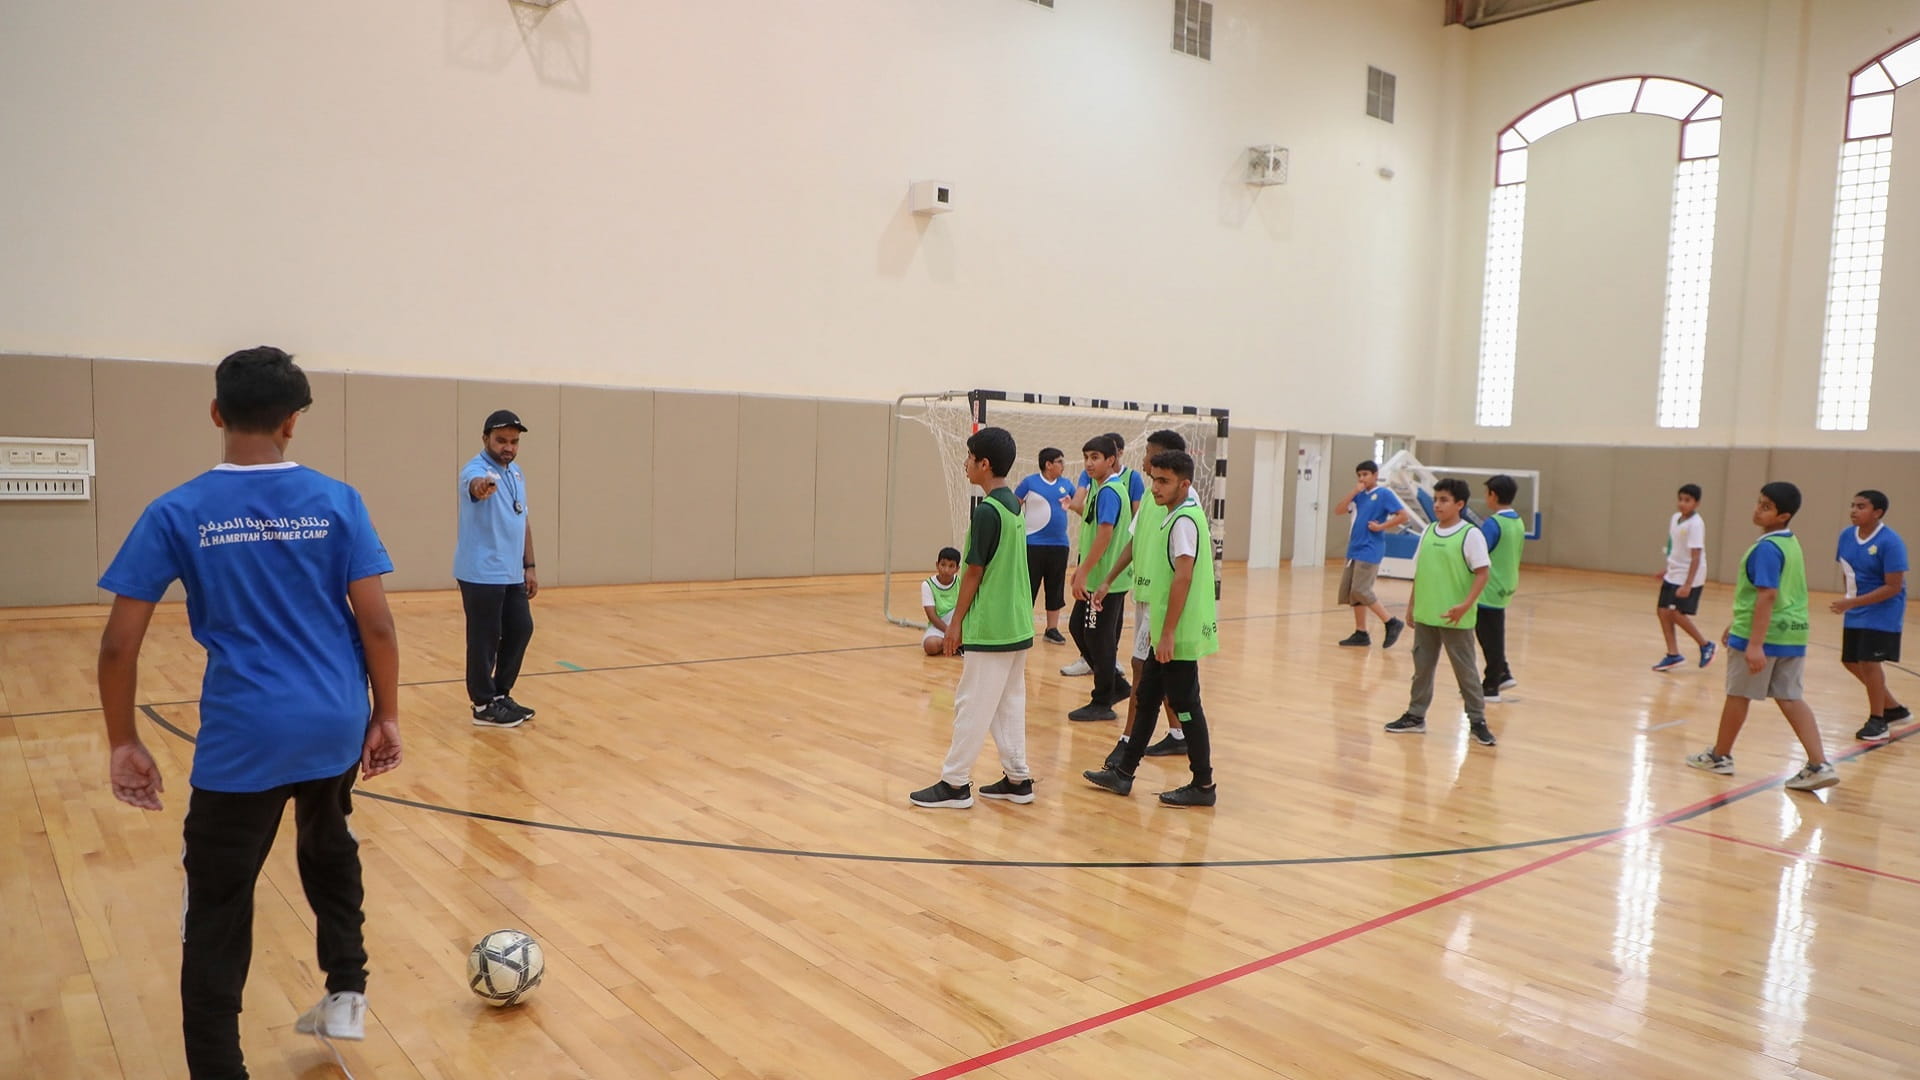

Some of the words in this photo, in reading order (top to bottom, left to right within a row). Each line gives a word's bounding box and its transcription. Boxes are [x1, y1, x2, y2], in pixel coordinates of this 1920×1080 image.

[290, 516, 330, 530] ملتقى
[199, 537, 211, 548] AL
[212, 532, 260, 545] HAMRIYAH
[262, 530, 301, 541] SUMMER
[302, 529, 328, 539] CAMP
